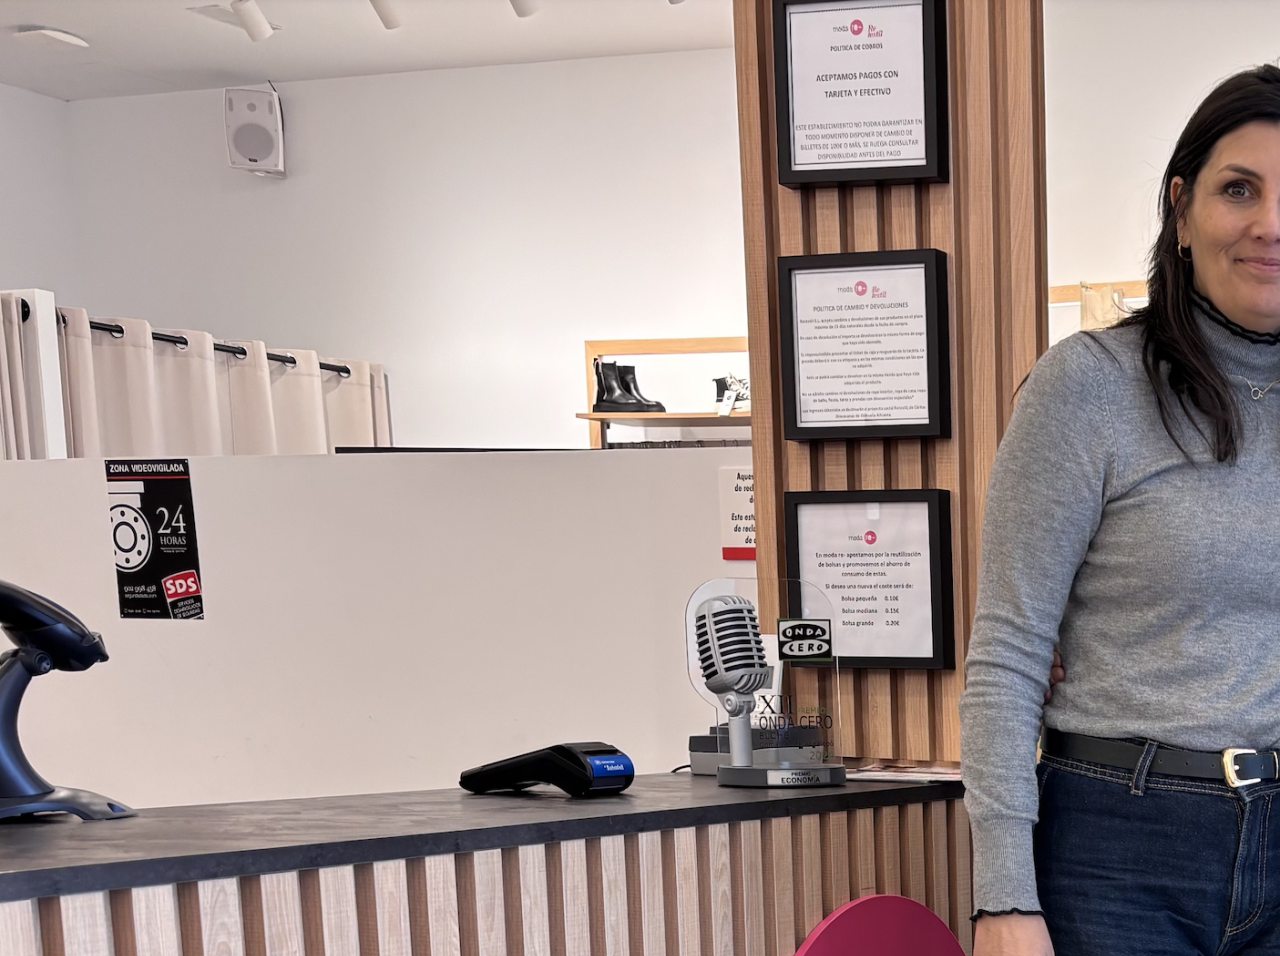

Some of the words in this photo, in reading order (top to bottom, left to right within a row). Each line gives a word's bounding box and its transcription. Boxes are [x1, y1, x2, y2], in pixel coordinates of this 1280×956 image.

[817, 72, 857, 82] ACEPTAMOS
[859, 71, 882, 80] PAGOS
[884, 70, 899, 79] CON
[825, 89, 852, 98] TARJETA
[860, 87, 891, 97] EFECTIVO
[110, 464, 129, 473] ZONA
[131, 464, 185, 473] VIDEOVIGILADA
[156, 504, 186, 534] 24
[731, 513, 743, 521] Este
[160, 536, 186, 545] HORAS
[166, 578, 197, 594] SDS
[785, 628, 823, 636] ONDA
[789, 643, 823, 652] CERO
[759, 716, 796, 730] ONDA
[800, 715, 833, 729] CERO
[781, 775, 820, 784] ECONOMÍA
